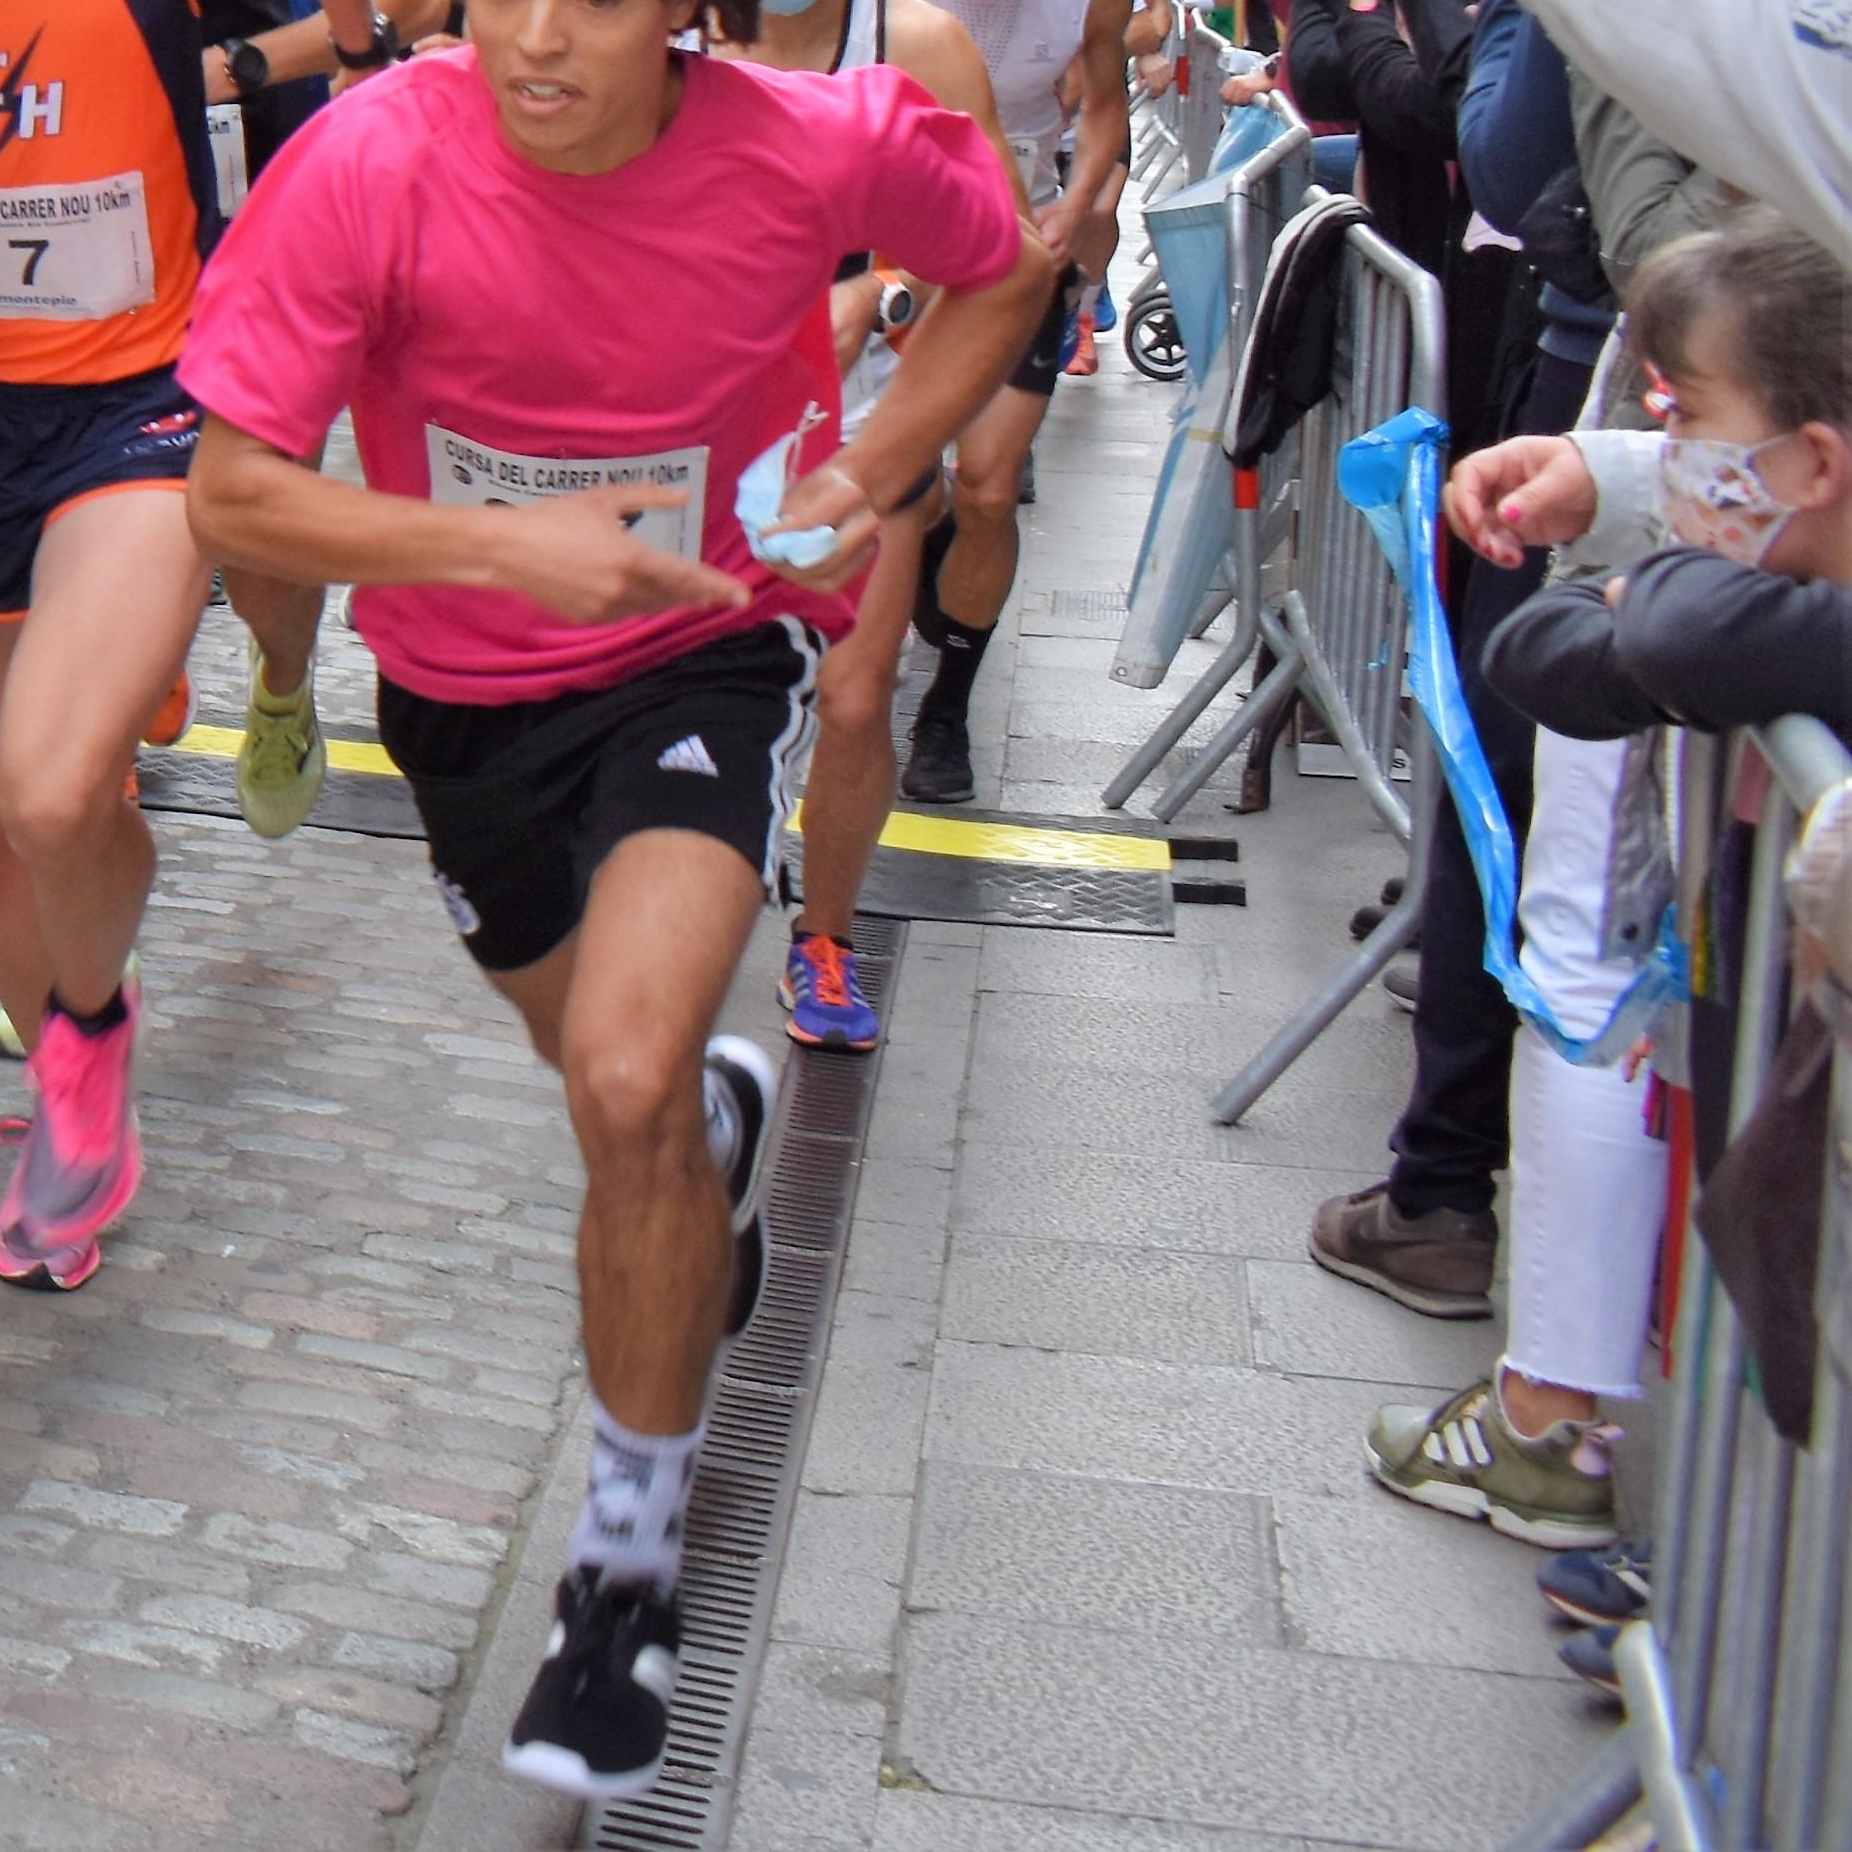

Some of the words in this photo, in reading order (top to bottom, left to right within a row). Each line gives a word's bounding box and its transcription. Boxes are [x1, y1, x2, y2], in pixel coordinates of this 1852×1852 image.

[0, 198, 56, 220] CARRER
[59, 195, 91, 217] NOU
[94, 189, 132, 213] 10km
[7, 239, 50, 286] 7
[445, 438, 493, 478] CURSA
[498, 460, 529, 487] DEL
[534, 467, 602, 491] CARRER
